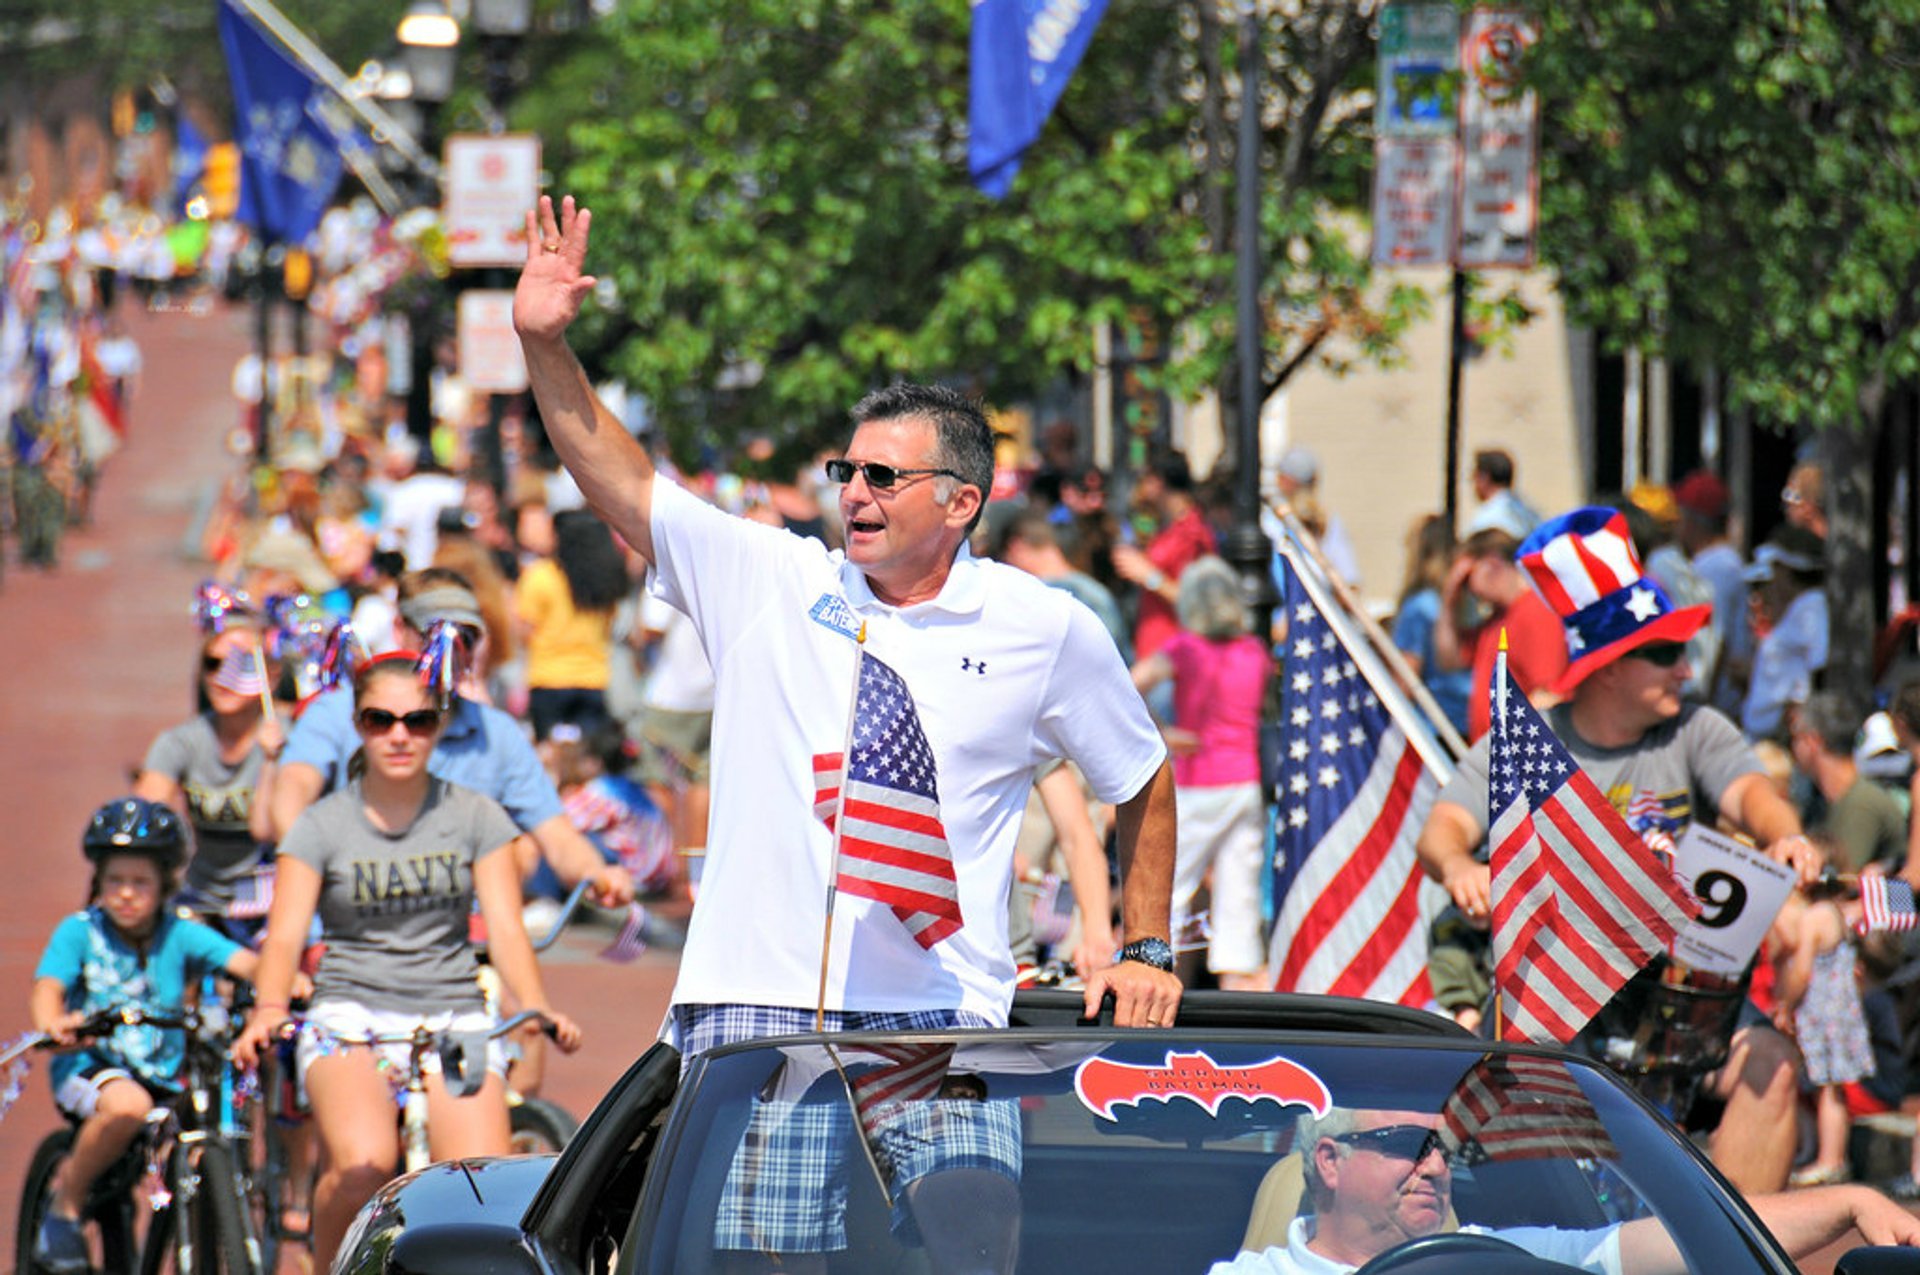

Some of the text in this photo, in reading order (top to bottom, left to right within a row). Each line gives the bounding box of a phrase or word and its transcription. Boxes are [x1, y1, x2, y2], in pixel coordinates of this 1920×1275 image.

[352, 852, 463, 906] NAVY
[1694, 870, 1747, 929] 9
[1148, 1080, 1263, 1092] BATEMAN
